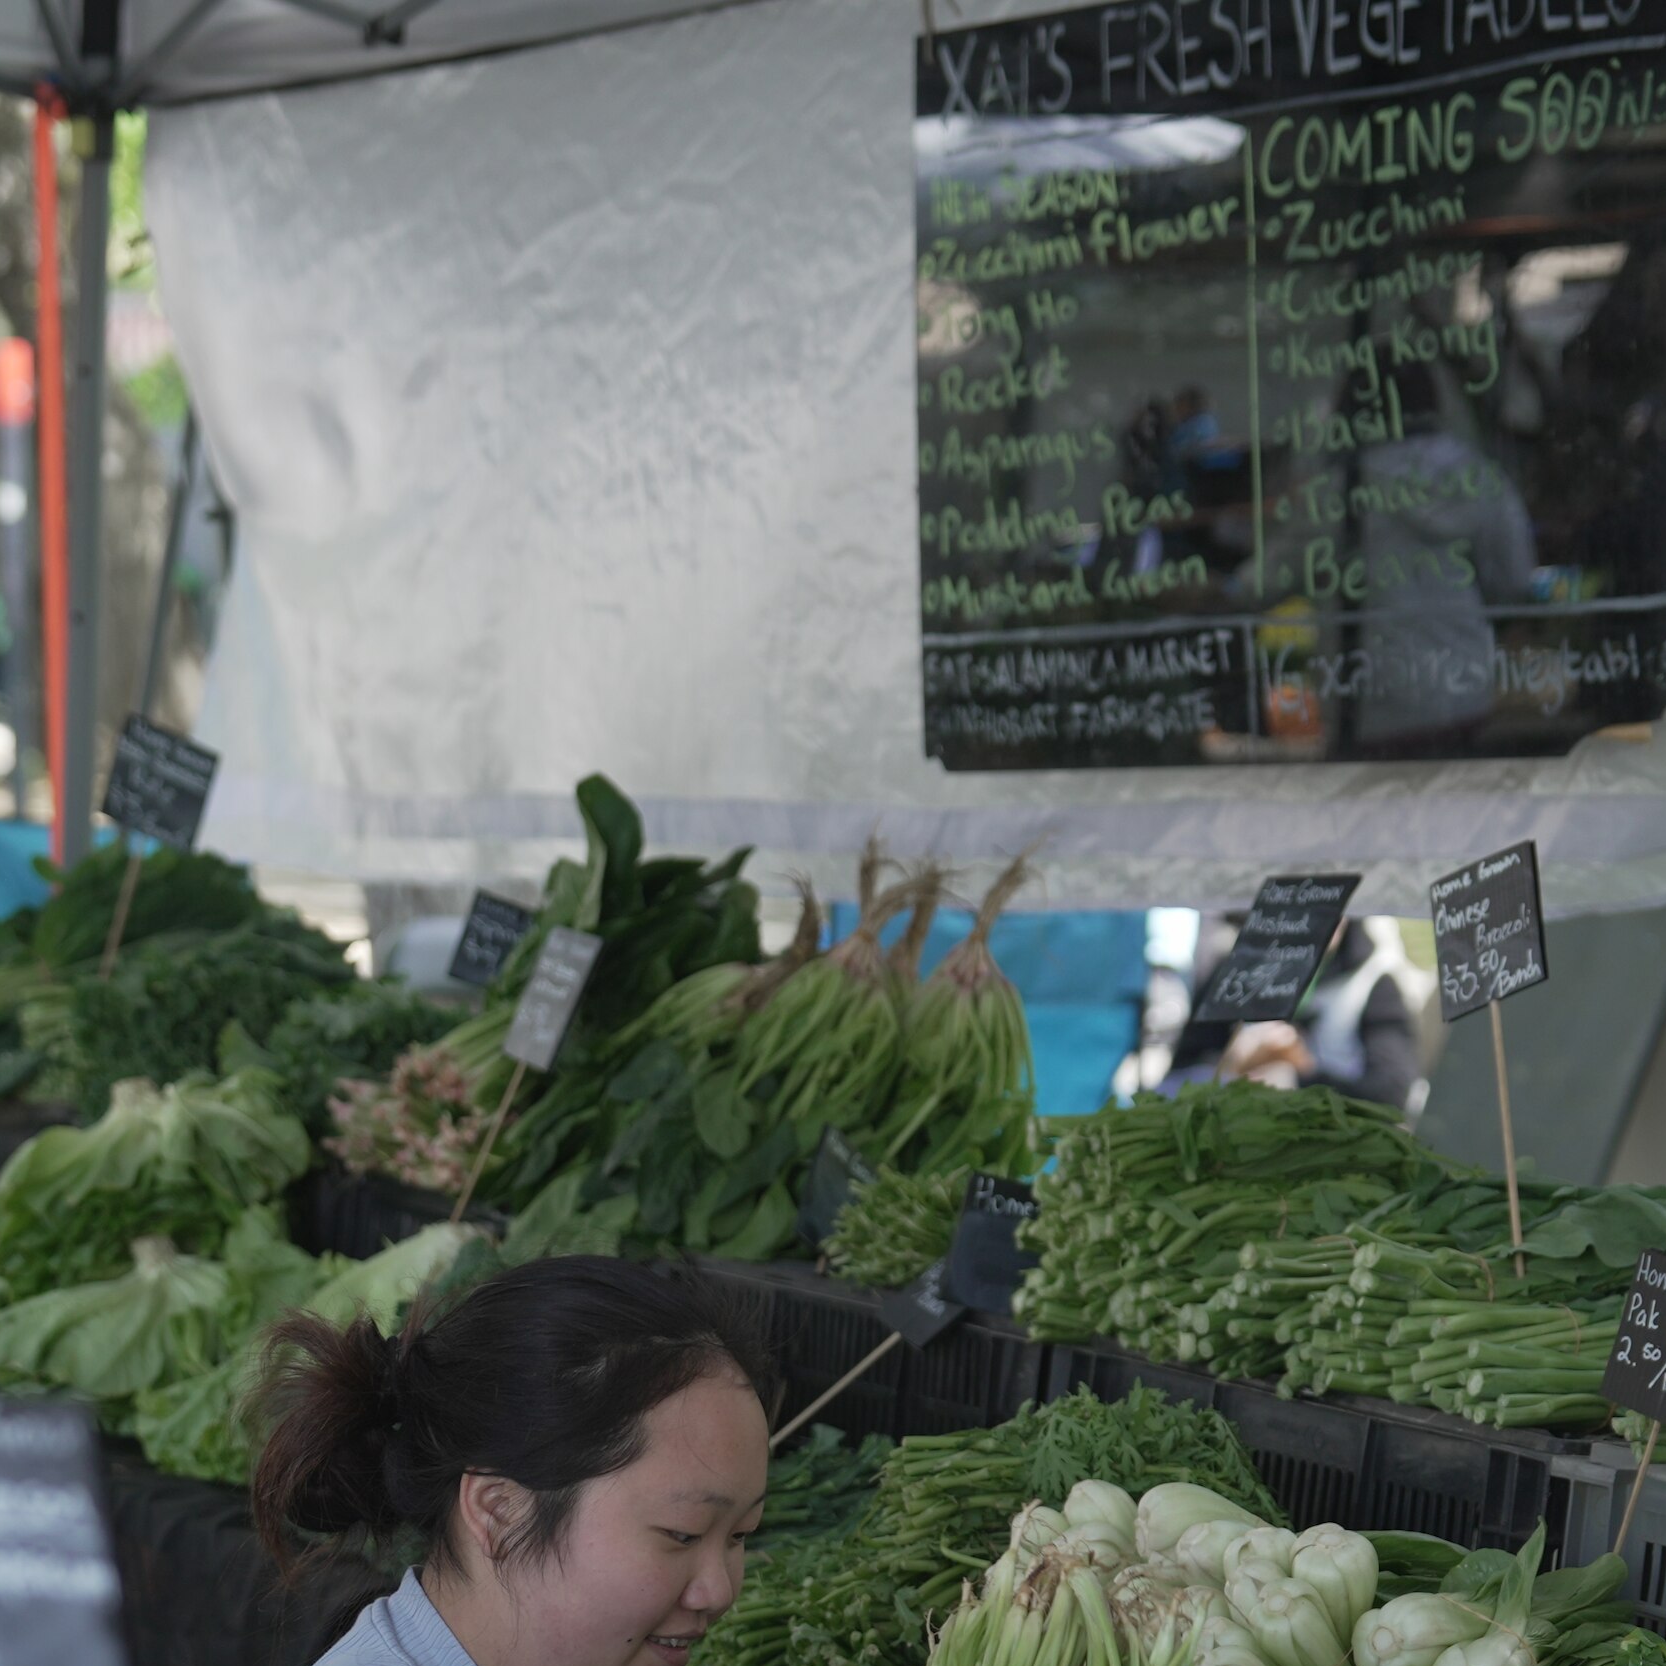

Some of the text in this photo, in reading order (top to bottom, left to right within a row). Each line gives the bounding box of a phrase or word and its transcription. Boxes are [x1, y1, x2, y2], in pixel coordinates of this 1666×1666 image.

[1099, 0, 1273, 104] FRESH
[1291, 0, 1641, 80] VEGETA
[1259, 92, 1476, 198] COMING
[1283, 187, 1467, 262] Zucchini
[1028, 288, 1080, 332] Ho
[1283, 250, 1484, 323] Cucumber
[938, 345, 1074, 416] Rocket
[1390, 314, 1500, 394] Kong
[1292, 374, 1405, 450] Basil
[938, 427, 1117, 498] Asparagus
[1102, 480, 1195, 538] Peas
[939, 552, 1211, 620] Mustard Green
[1303, 537, 1477, 600] Beans
[1433, 869, 1473, 903] Home
[1435, 897, 1491, 937] Chinese
[1473, 902, 1532, 954] Broccoli
[973, 1175, 1035, 1216] Home
[1627, 1292, 1660, 1330] Pak
